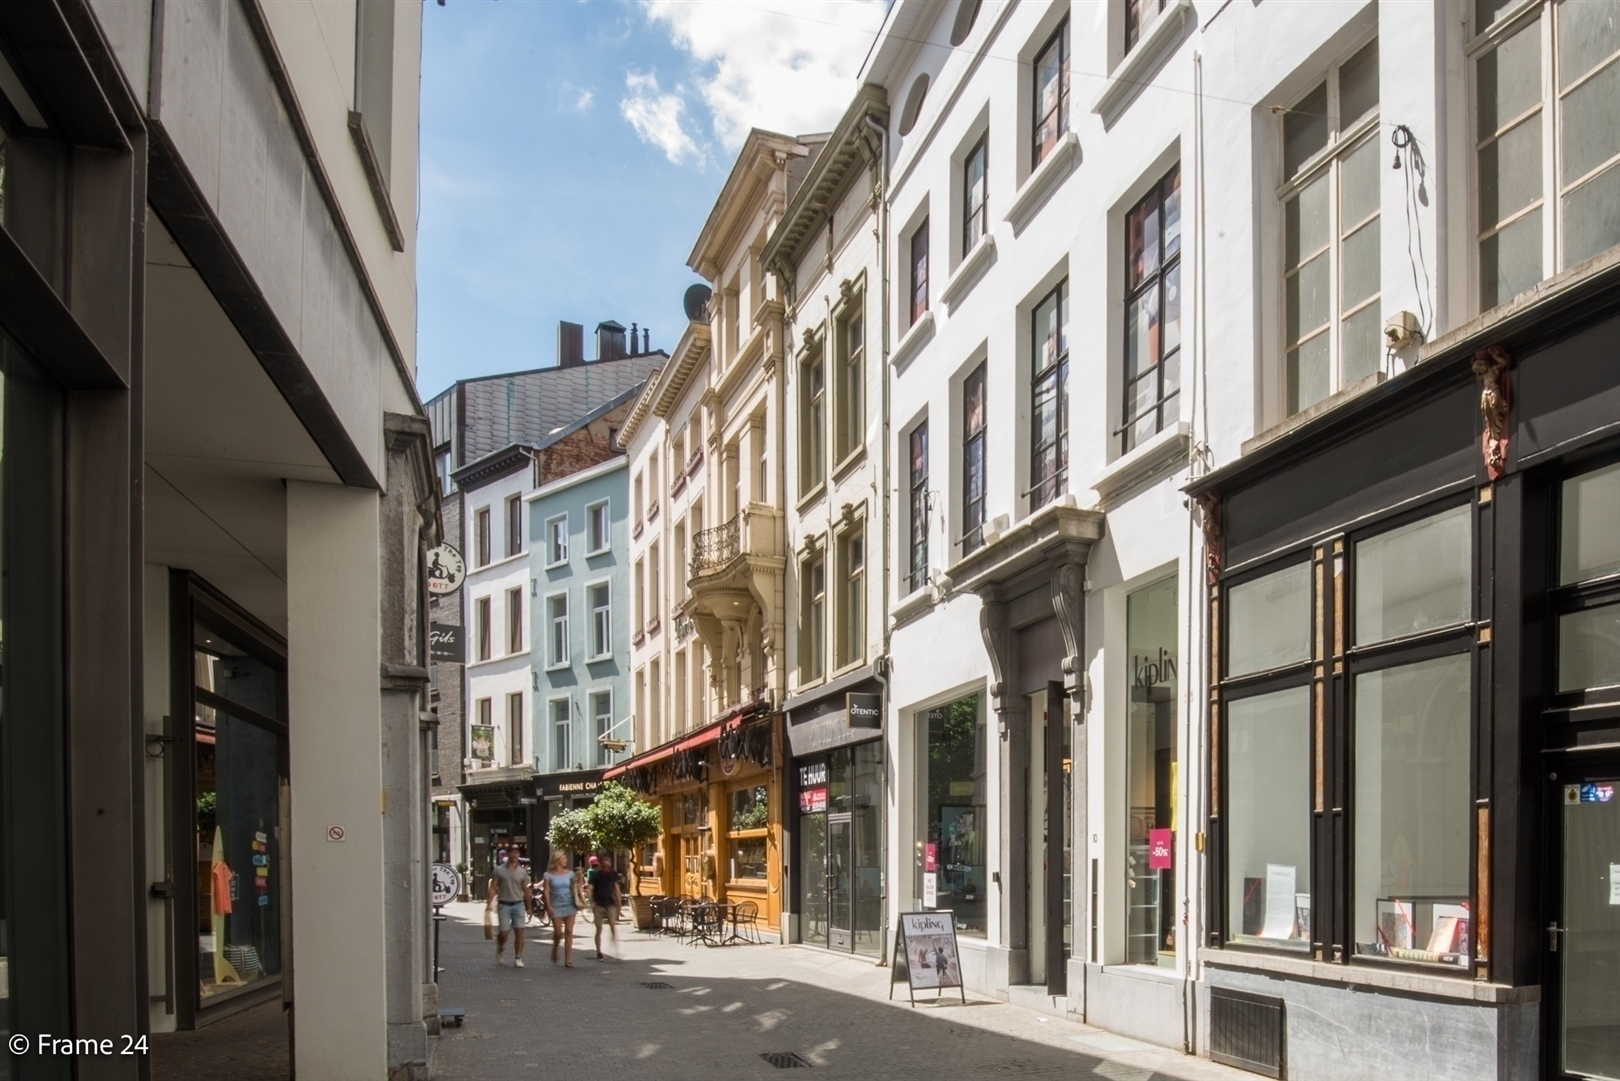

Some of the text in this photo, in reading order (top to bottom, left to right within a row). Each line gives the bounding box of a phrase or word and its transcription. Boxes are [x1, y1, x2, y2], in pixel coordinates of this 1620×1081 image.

[443, 545, 457, 558] The
[850, 707, 880, 716] OTENTIC
[799, 762, 827, 786] TE HUUR
[559, 782, 584, 792] FABIENNE
[1092, 833, 1099, 843] 10
[1152, 846, 1169, 857] -50%
[911, 917, 945, 932] kipling
